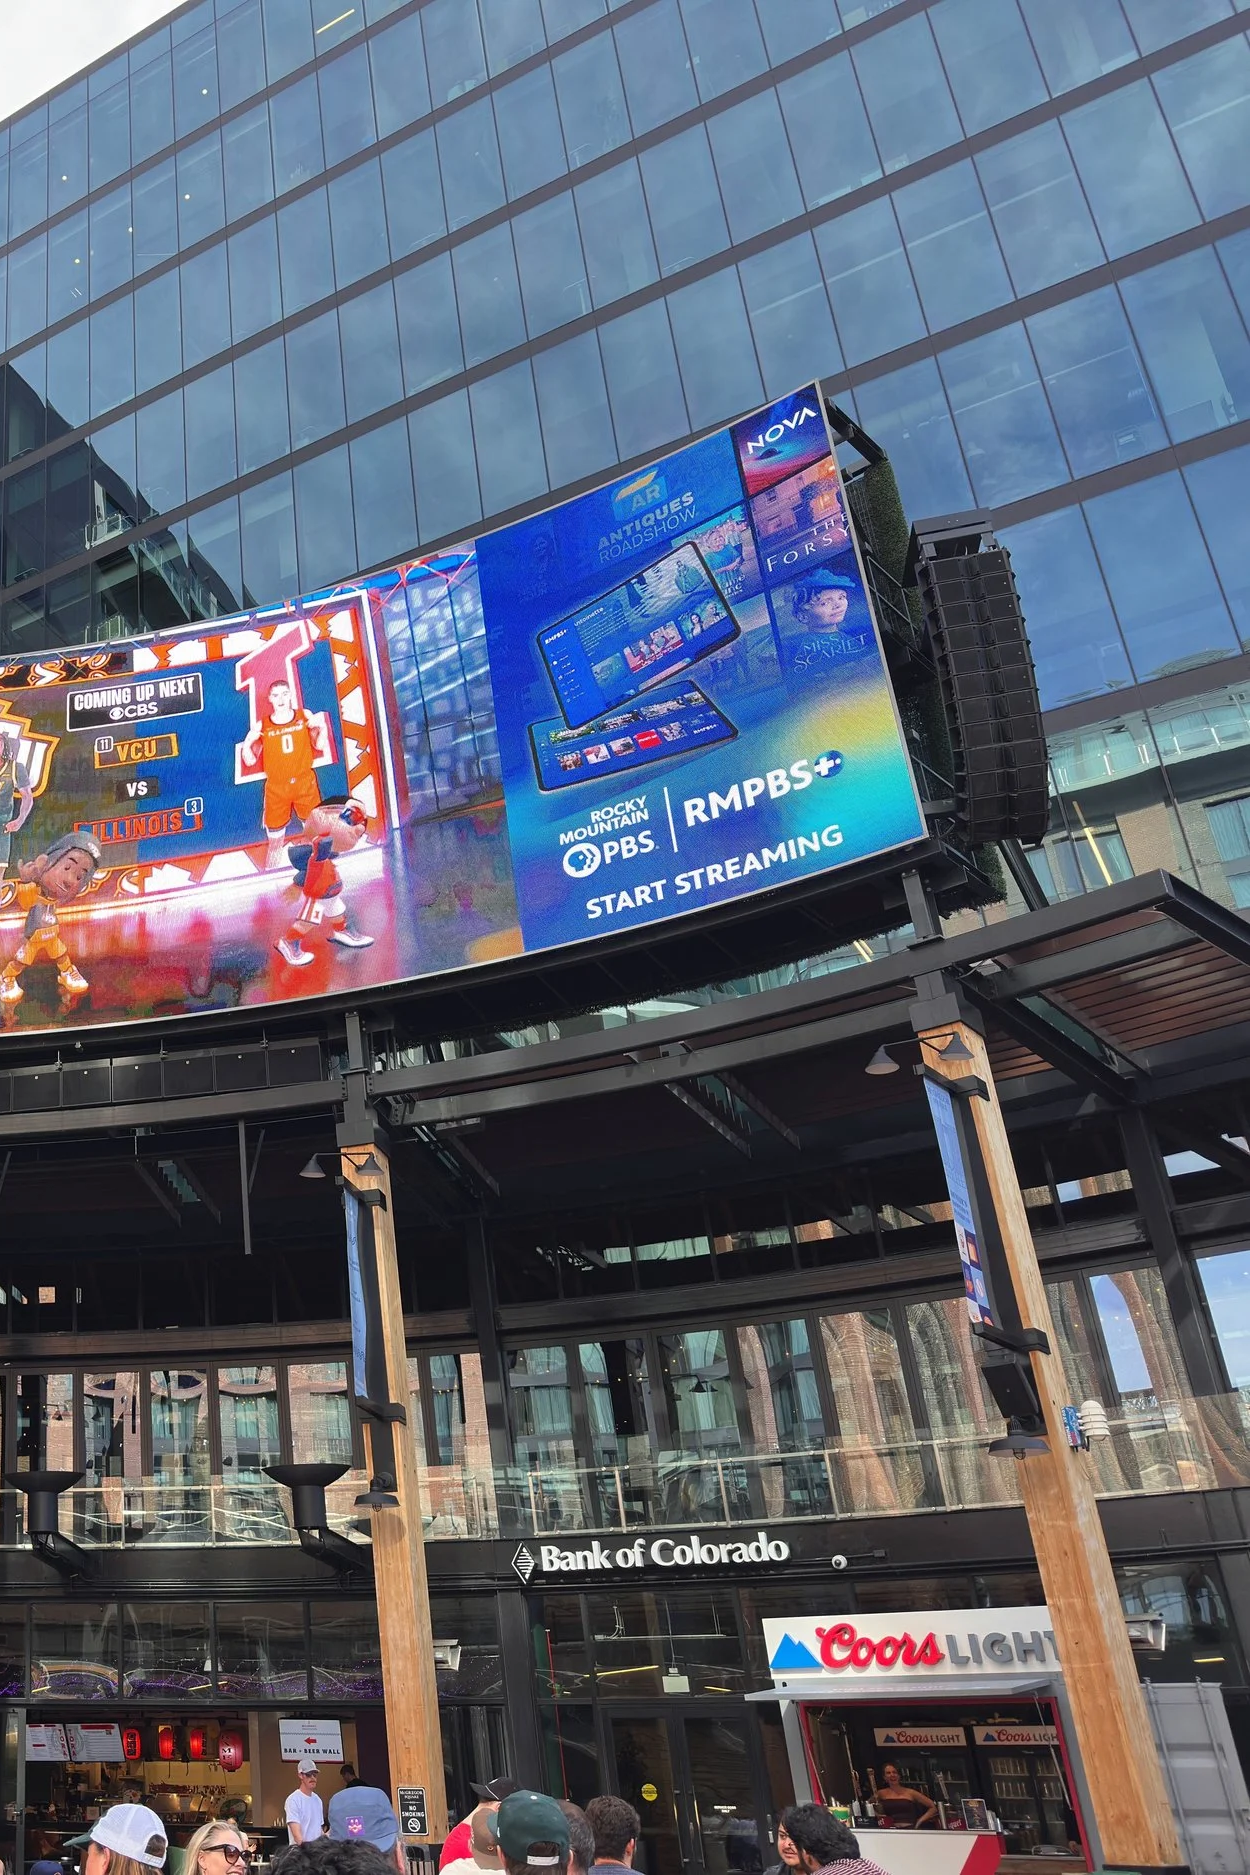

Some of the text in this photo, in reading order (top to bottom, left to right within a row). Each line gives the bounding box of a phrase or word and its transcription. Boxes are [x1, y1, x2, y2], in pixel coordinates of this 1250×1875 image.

[745, 407, 817, 455] NOVA
[630, 484, 661, 512] AR
[597, 491, 695, 550] ANTIQUES
[599, 504, 698, 565] ROADSHOW
[811, 512, 849, 536] THE
[793, 633, 867, 673] SCARLET
[802, 636, 839, 656] MISS
[74, 677, 195, 711] COMING UP NEXT
[124, 701, 158, 718] CBS
[117, 740, 157, 762] VCU
[281, 734, 294, 754] 0
[126, 781, 148, 797] VS
[190, 800, 198, 813] 3
[590, 795, 648, 823] ROCKY
[92, 812, 183, 842] ILLINOIS
[558, 808, 650, 846] MOUNTAIN
[603, 831, 657, 864] PBS
[586, 824, 844, 920] START STREAMING
[540, 1531, 791, 1572] Bank of Colorado
[815, 1622, 946, 1669] Coors
[895, 1731, 961, 1745] Coors LIGHT
[996, 1729, 1060, 1743] Coors LIGH
